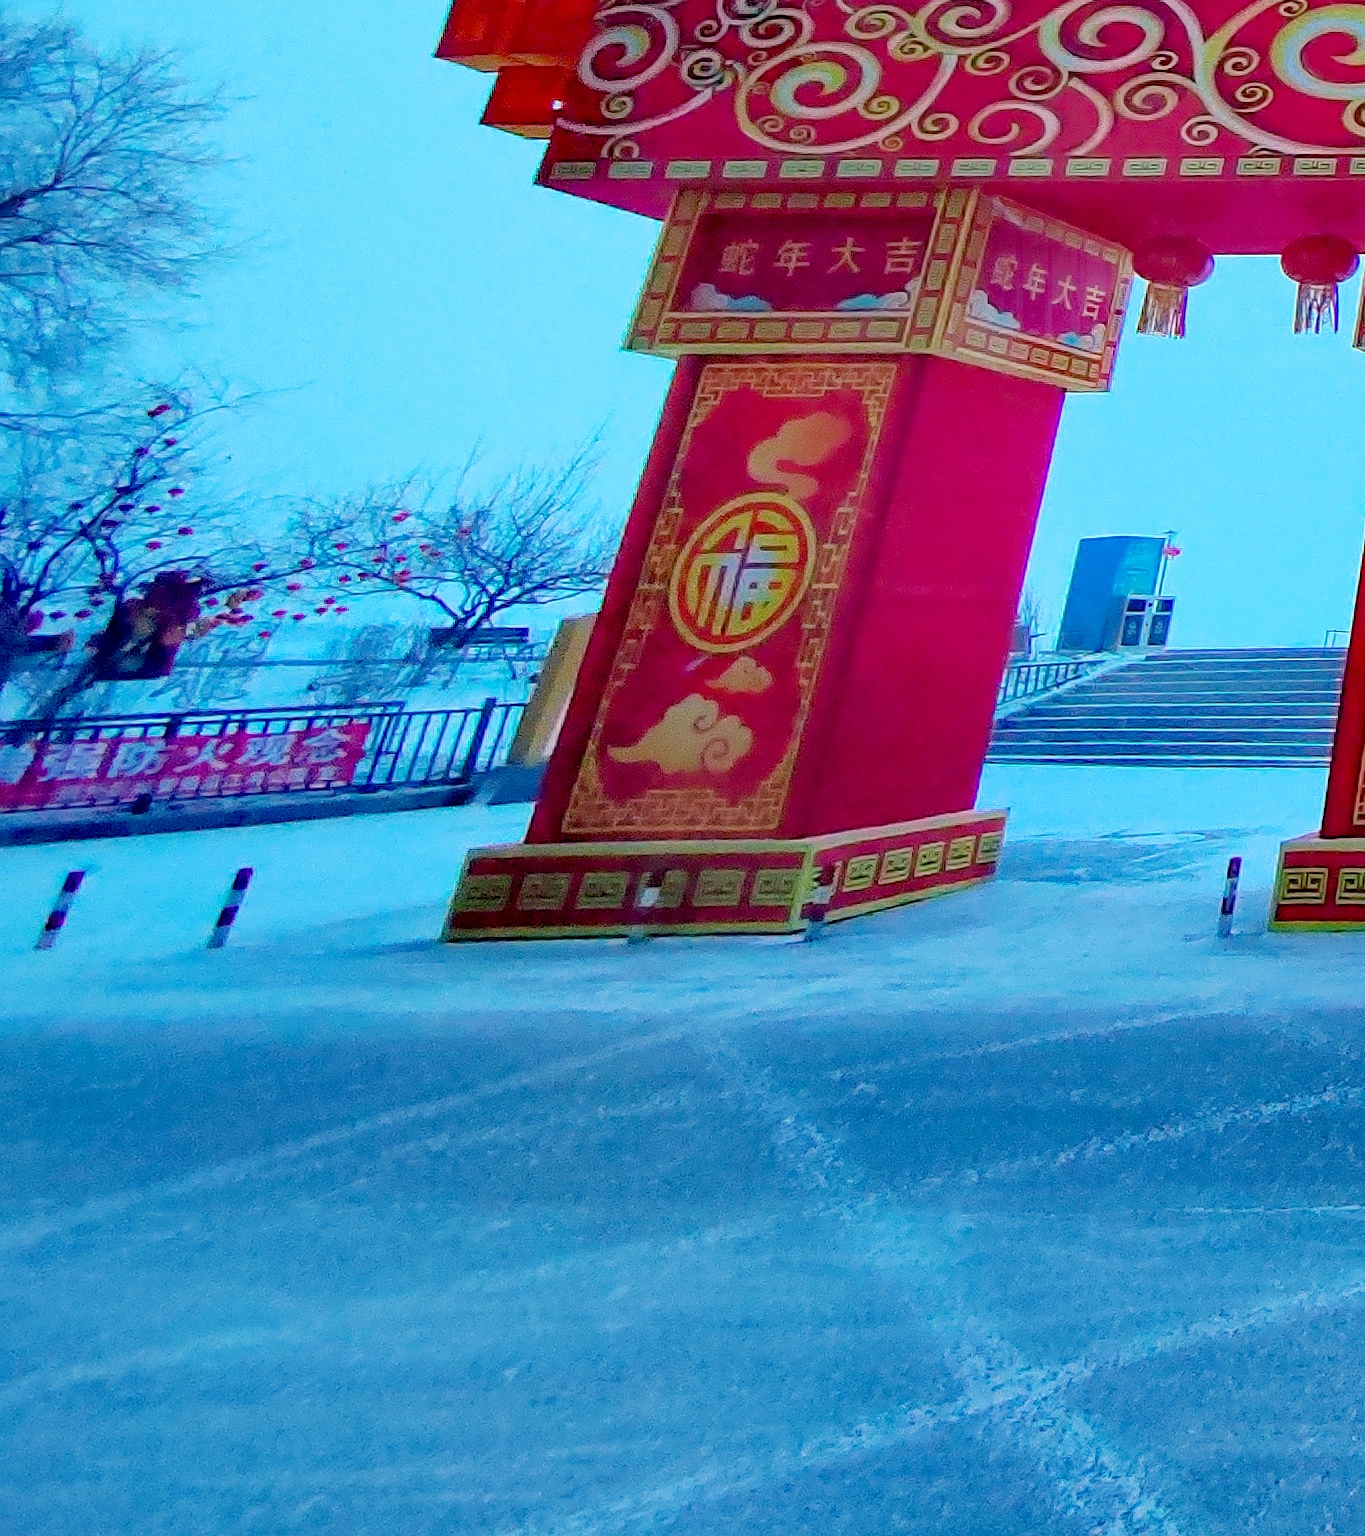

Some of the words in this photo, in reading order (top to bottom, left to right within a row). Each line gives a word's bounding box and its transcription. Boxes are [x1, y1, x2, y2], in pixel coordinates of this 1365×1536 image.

[719, 237, 925, 276] 蛇年大吉
[993, 255, 1107, 322] 蛇年大吉
